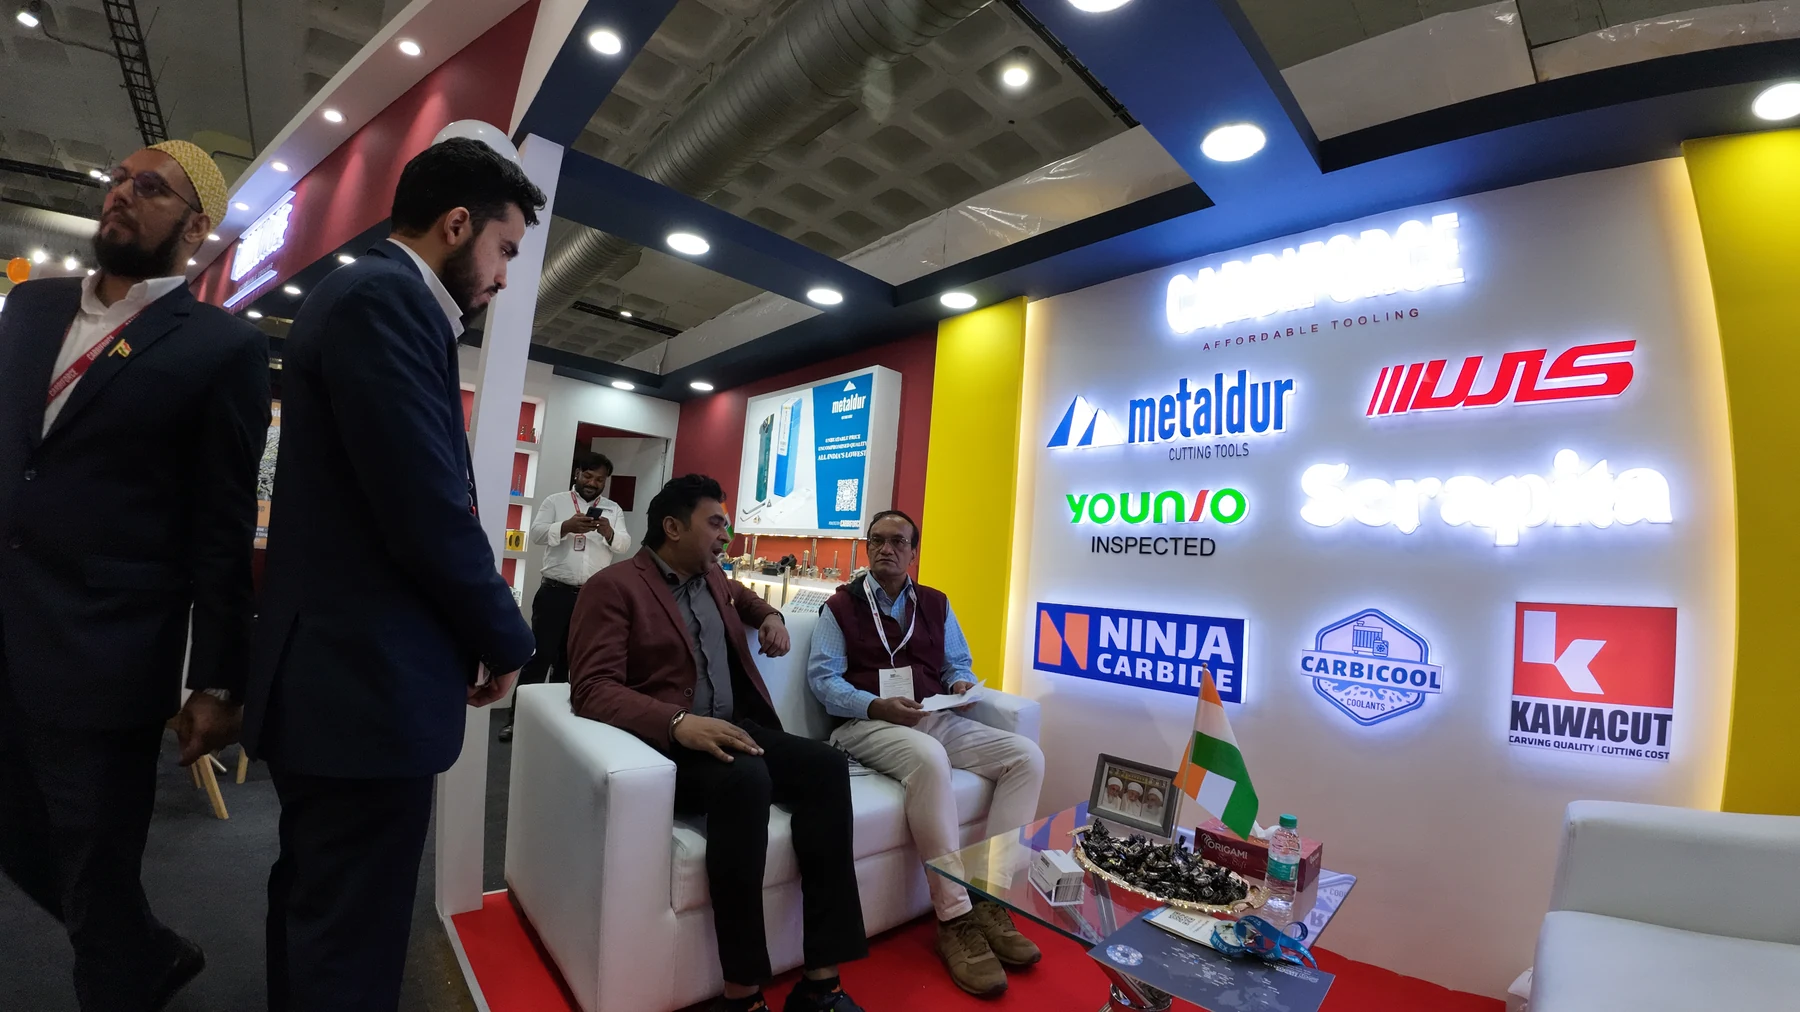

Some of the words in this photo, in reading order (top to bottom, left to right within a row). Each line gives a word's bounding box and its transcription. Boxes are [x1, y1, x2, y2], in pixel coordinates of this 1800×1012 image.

[1203, 323, 1319, 351] AFFORDABLE
[1331, 307, 1420, 330] TOOLING
[832, 393, 867, 414] metaldur
[1128, 369, 1295, 444] metaldur
[818, 453, 828, 461] ALL
[845, 450, 867, 459] LOWEST
[1169, 444, 1212, 461] CUTTING
[1215, 442, 1250, 459] TOOLS
[1091, 535, 1217, 557] INSPECTED
[1099, 615, 1236, 664] NINJA
[1301, 655, 1441, 689] CARBICOOL
[1346, 698, 1386, 711] COOLANTS
[1510, 700, 1673, 747] KAWACUT
[1509, 735, 1551, 748] CARVING
[1553, 740, 1595, 752] QUALITY
[1601, 745, 1643, 758] CUTTING
[1644, 750, 1670, 760] COST
[1207, 841, 1248, 860] ORIGAMI
